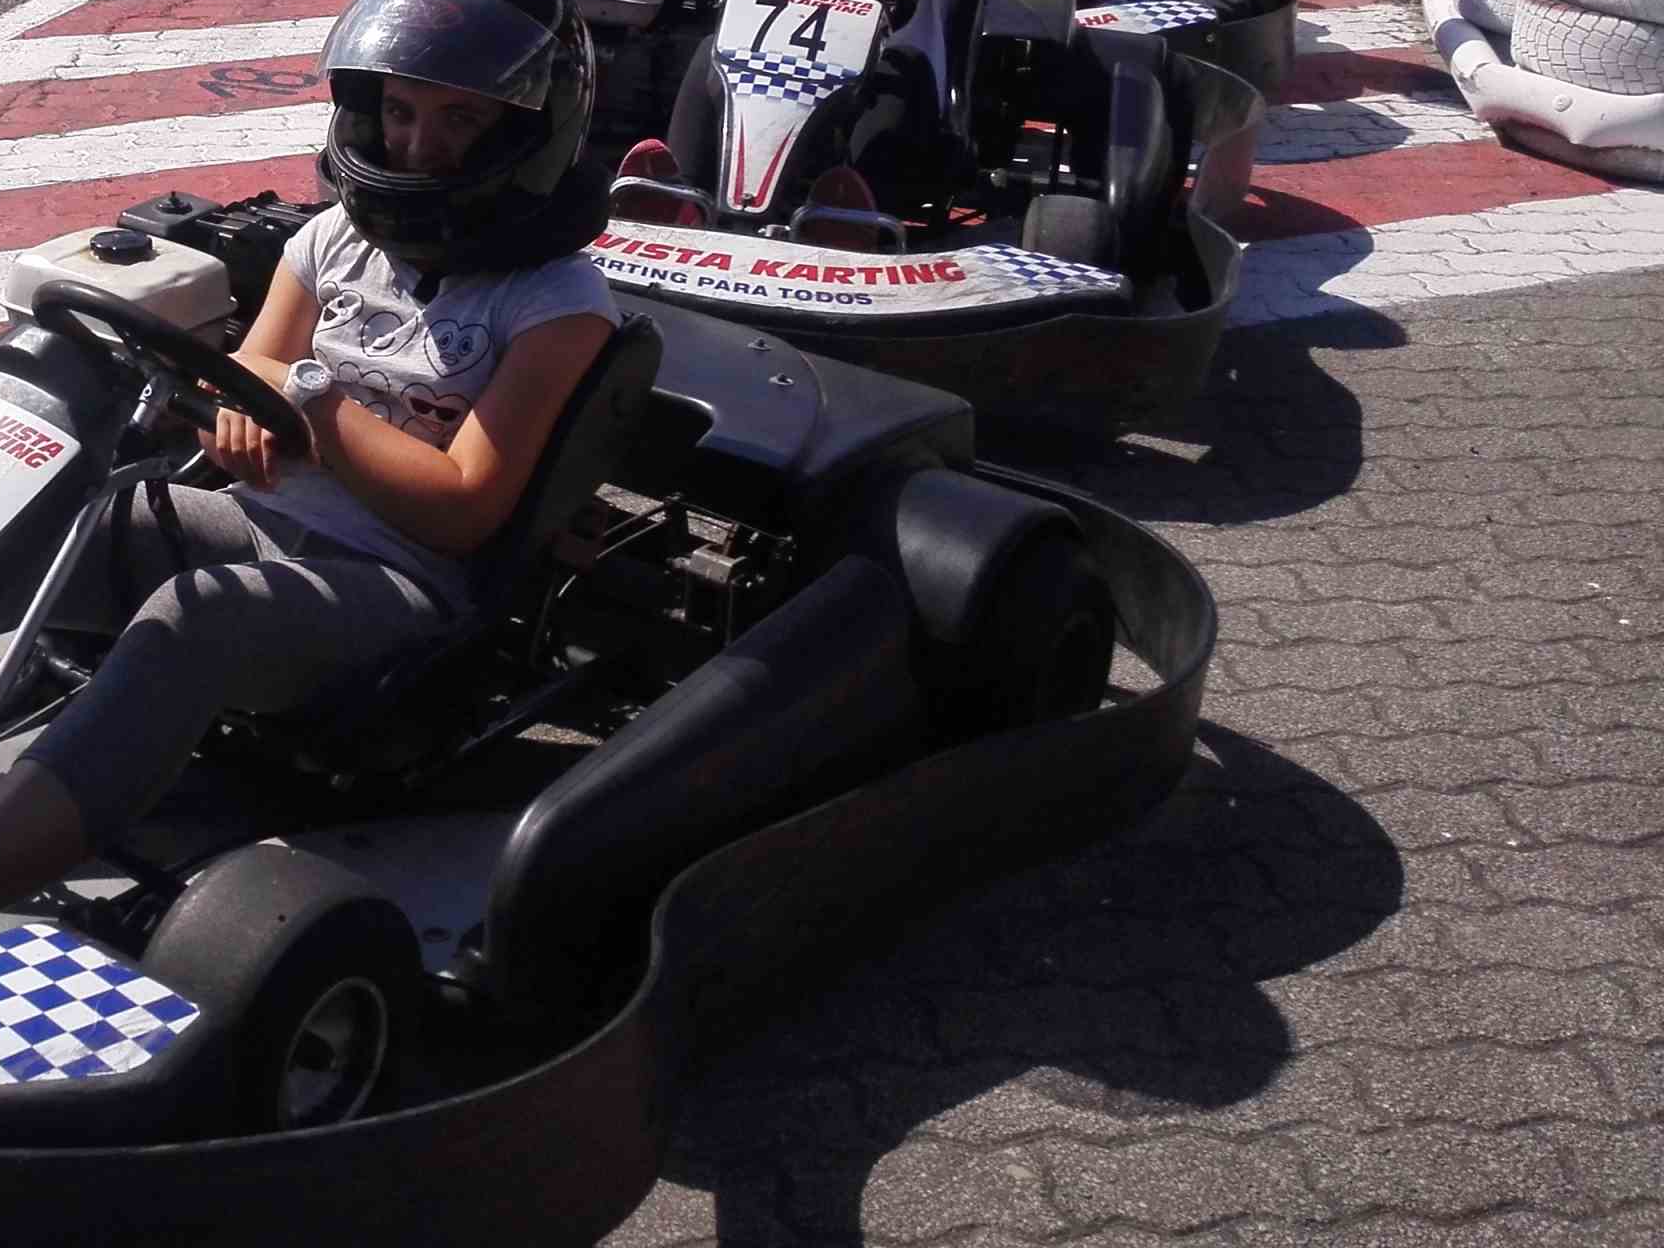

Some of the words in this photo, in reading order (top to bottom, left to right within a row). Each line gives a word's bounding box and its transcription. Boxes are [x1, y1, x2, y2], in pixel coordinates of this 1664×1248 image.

[592, 232, 734, 271] VISTA
[749, 257, 967, 286] KARTING
[696, 275, 768, 297] PARA
[777, 287, 873, 306] TODOS
